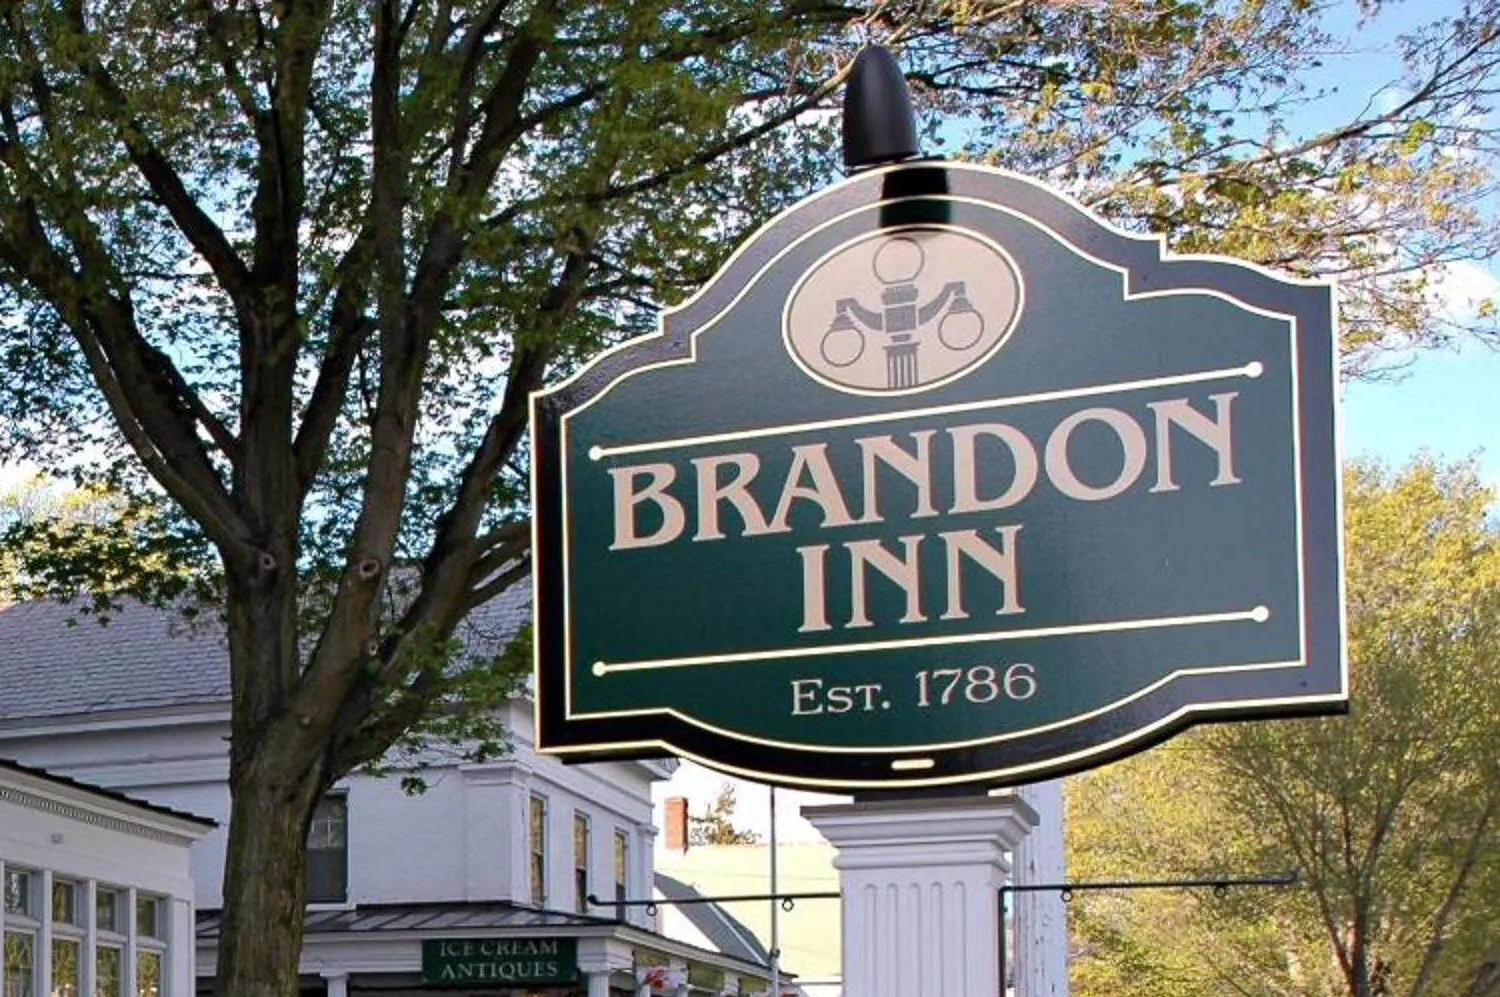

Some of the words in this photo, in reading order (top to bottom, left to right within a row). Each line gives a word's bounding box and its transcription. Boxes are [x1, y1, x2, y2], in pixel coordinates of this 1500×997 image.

[608, 393, 1241, 551] BRANDON
[796, 526, 1025, 632] INN
[915, 663, 1038, 707] 1786
[440, 942, 475, 957] ICE
[481, 940, 558, 955] CREAM
[442, 961, 558, 981] ANTIQUES
